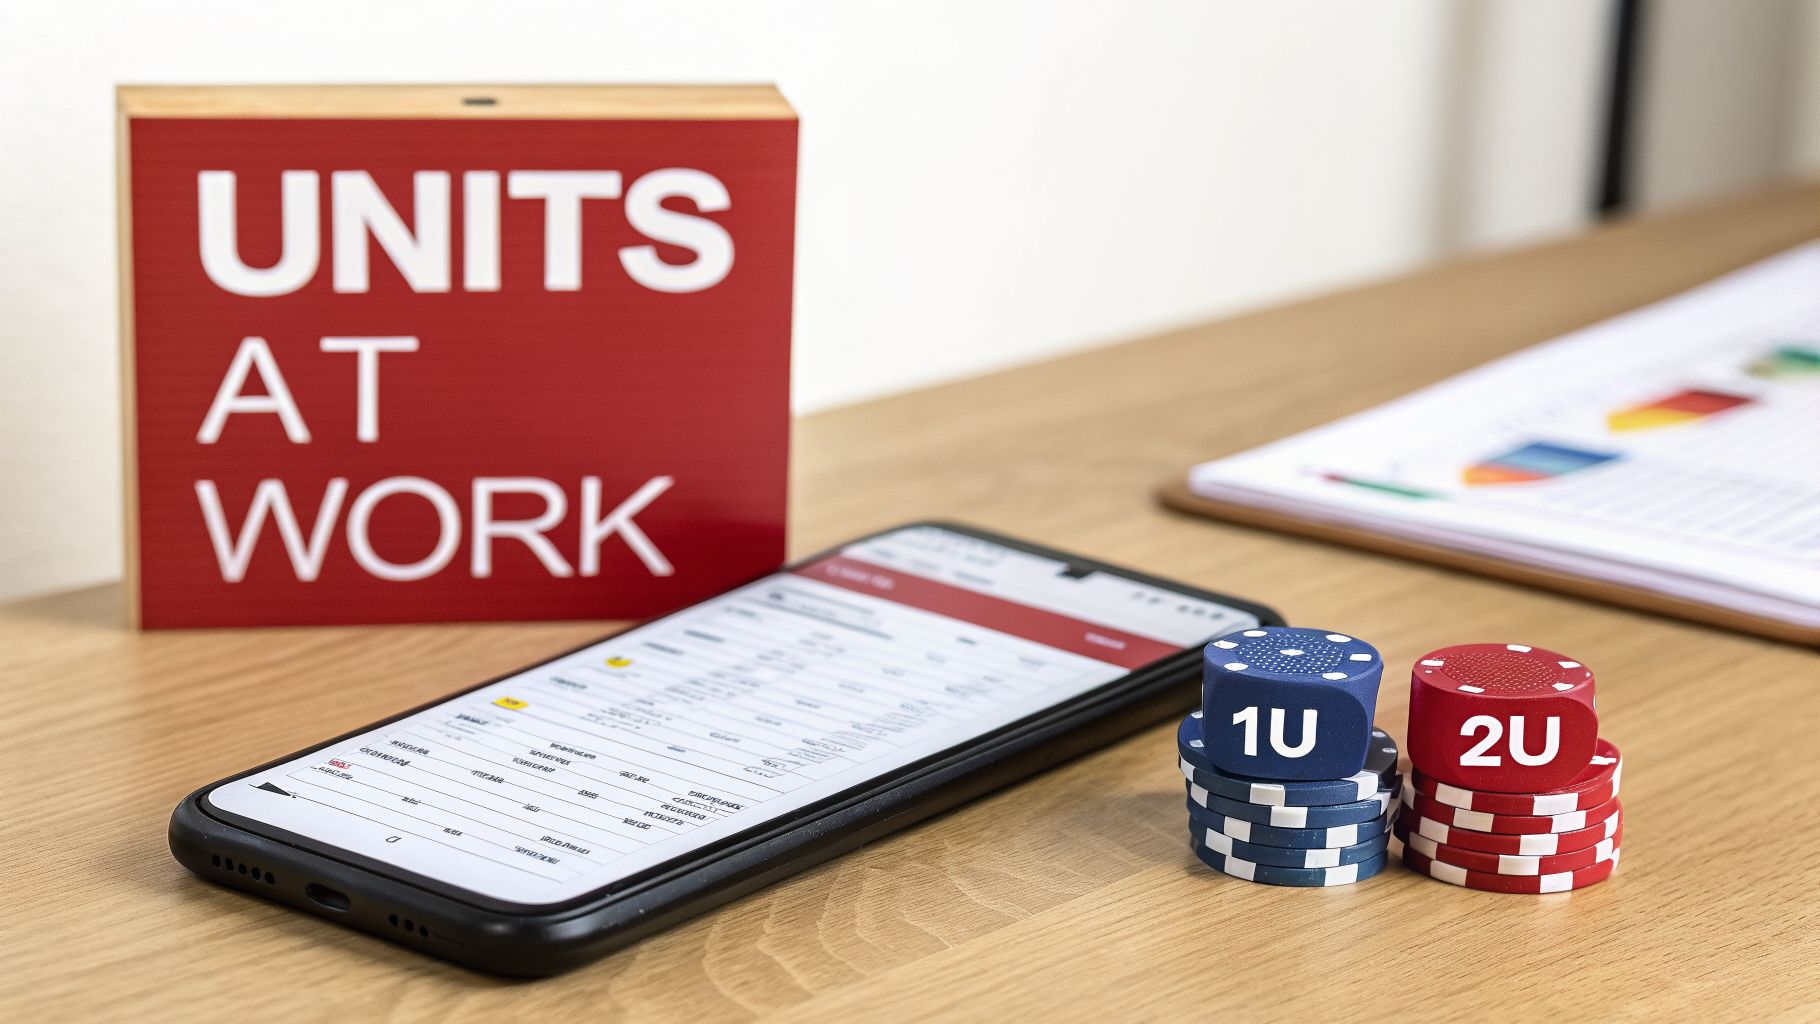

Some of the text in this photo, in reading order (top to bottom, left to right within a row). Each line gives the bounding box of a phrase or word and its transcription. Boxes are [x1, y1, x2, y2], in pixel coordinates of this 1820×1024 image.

[198, 168, 735, 296] UNITS
[198, 336, 419, 444] AT
[195, 476, 674, 582] WORK
[1232, 706, 1319, 759] 1U
[1459, 714, 1561, 767] 2U
